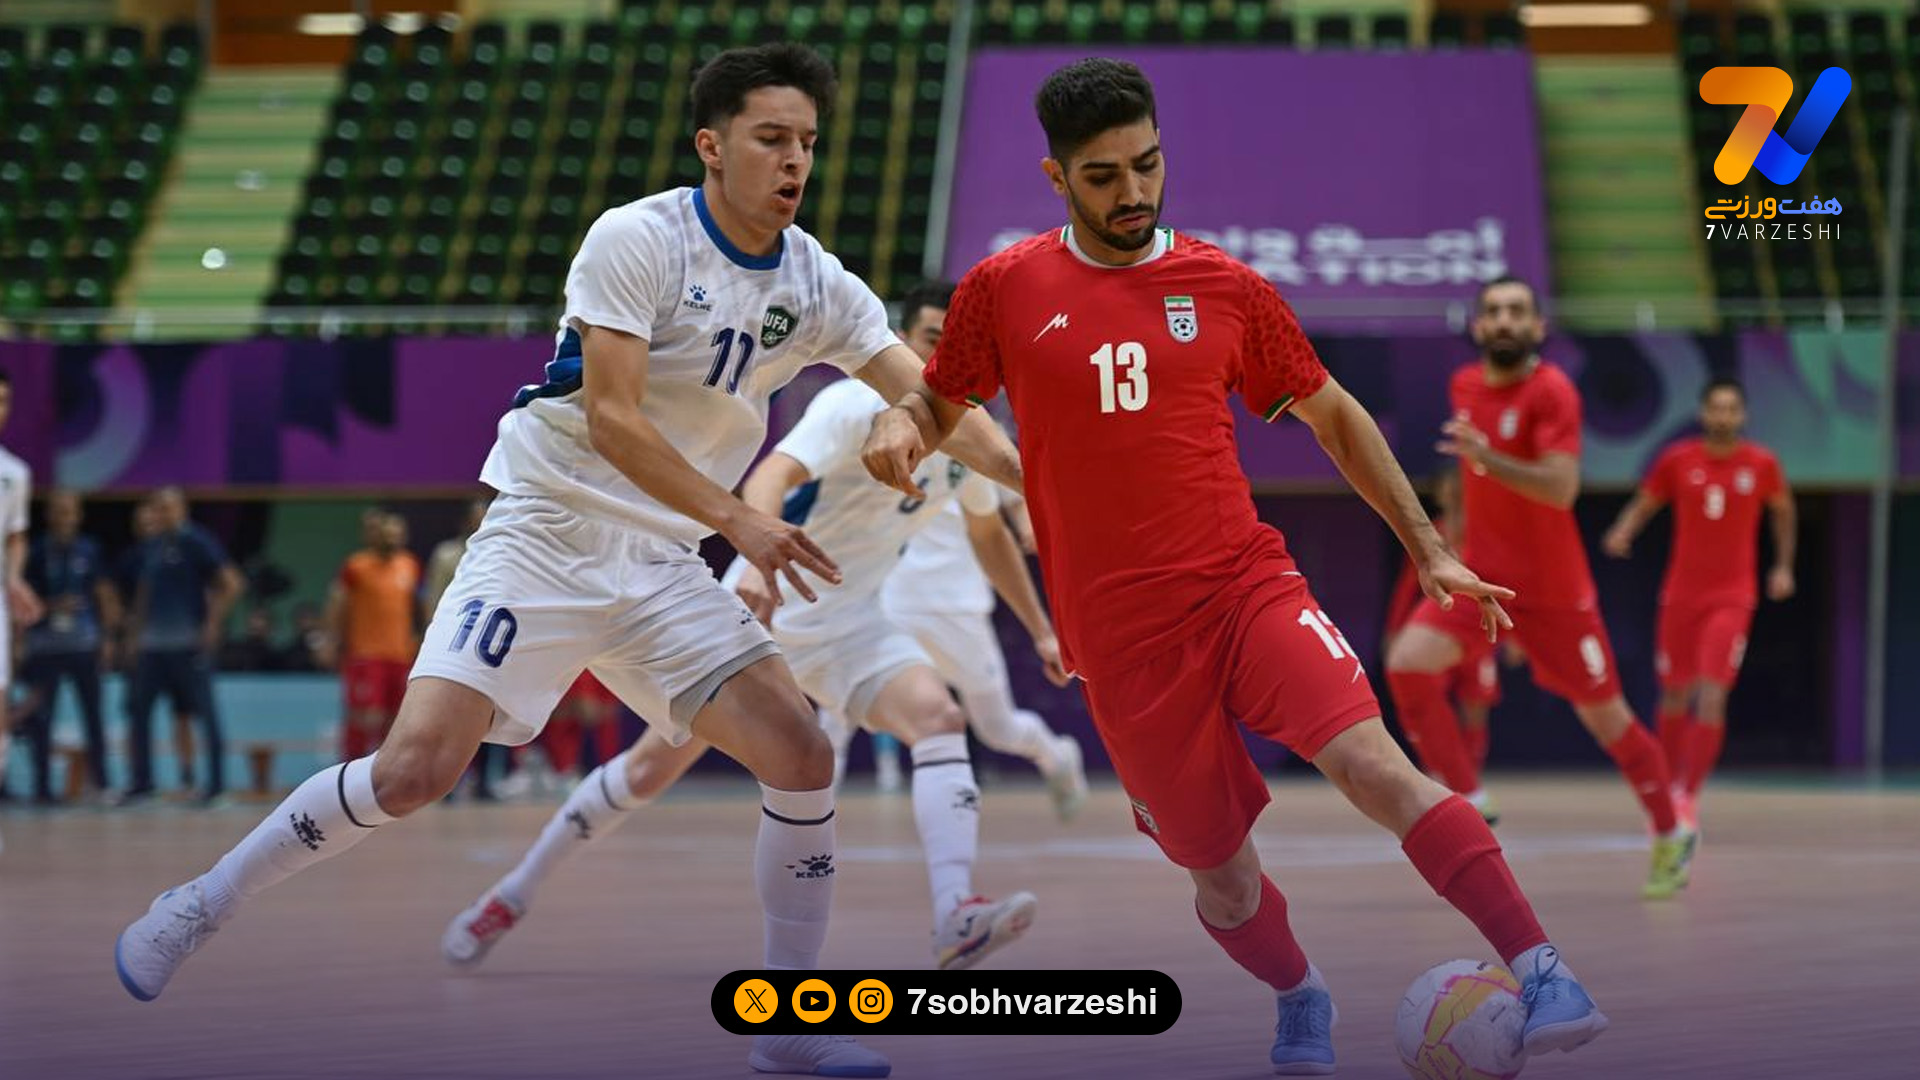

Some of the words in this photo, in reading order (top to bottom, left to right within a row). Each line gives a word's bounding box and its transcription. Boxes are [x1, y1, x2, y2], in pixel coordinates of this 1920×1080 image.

[763, 312, 789, 333] UFA
[1089, 342, 1149, 413] 13
[447, 598, 517, 668] 10
